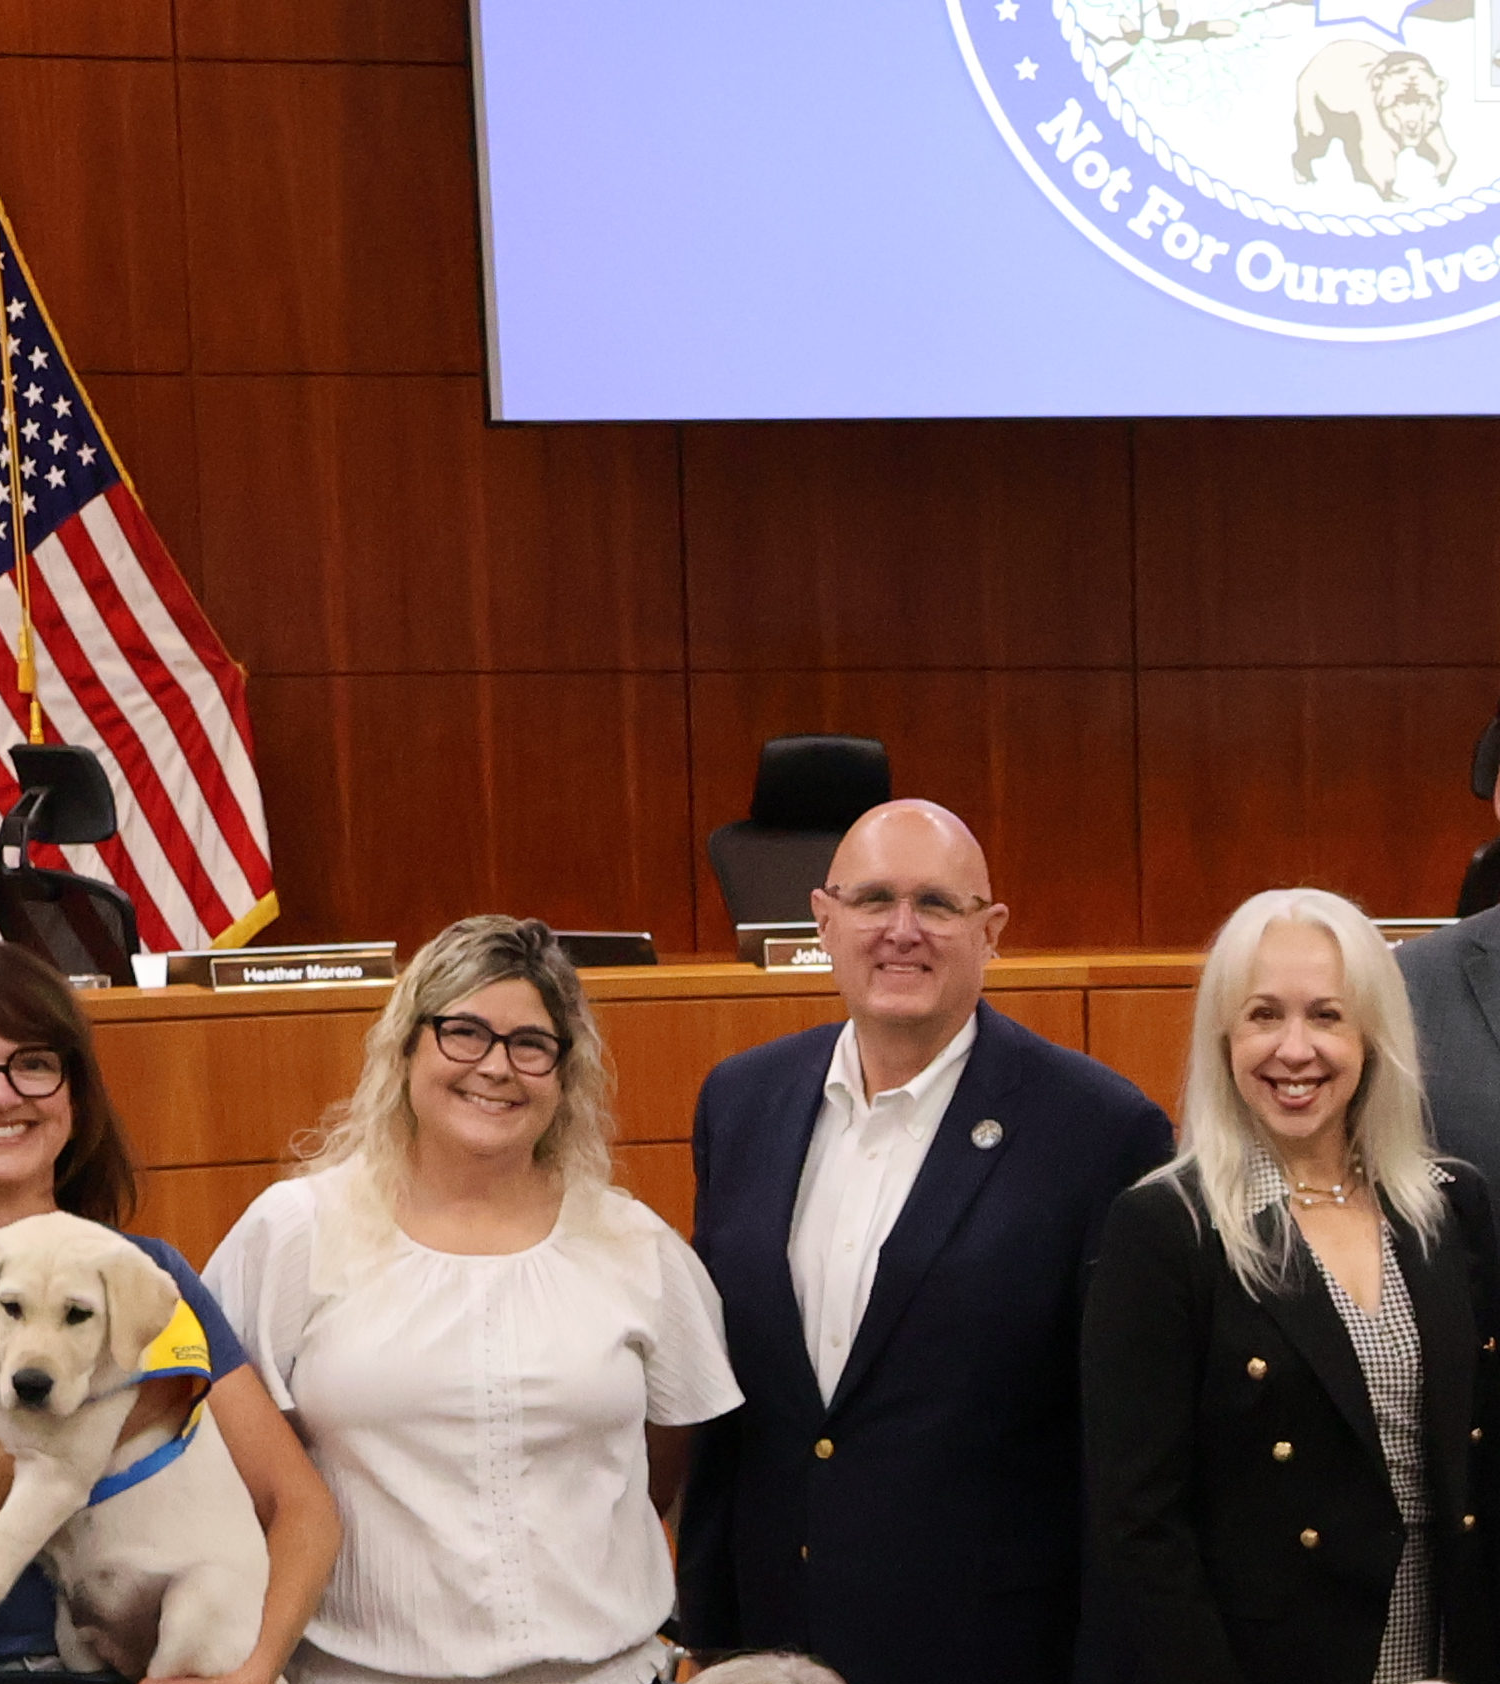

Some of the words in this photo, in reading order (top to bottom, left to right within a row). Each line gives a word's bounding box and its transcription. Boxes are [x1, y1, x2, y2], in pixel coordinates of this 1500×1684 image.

[1036, 98, 1134, 213] Not
[1127, 185, 1231, 273] For
[243, 966, 304, 983] Heather
[305, 963, 364, 980] Moreno
